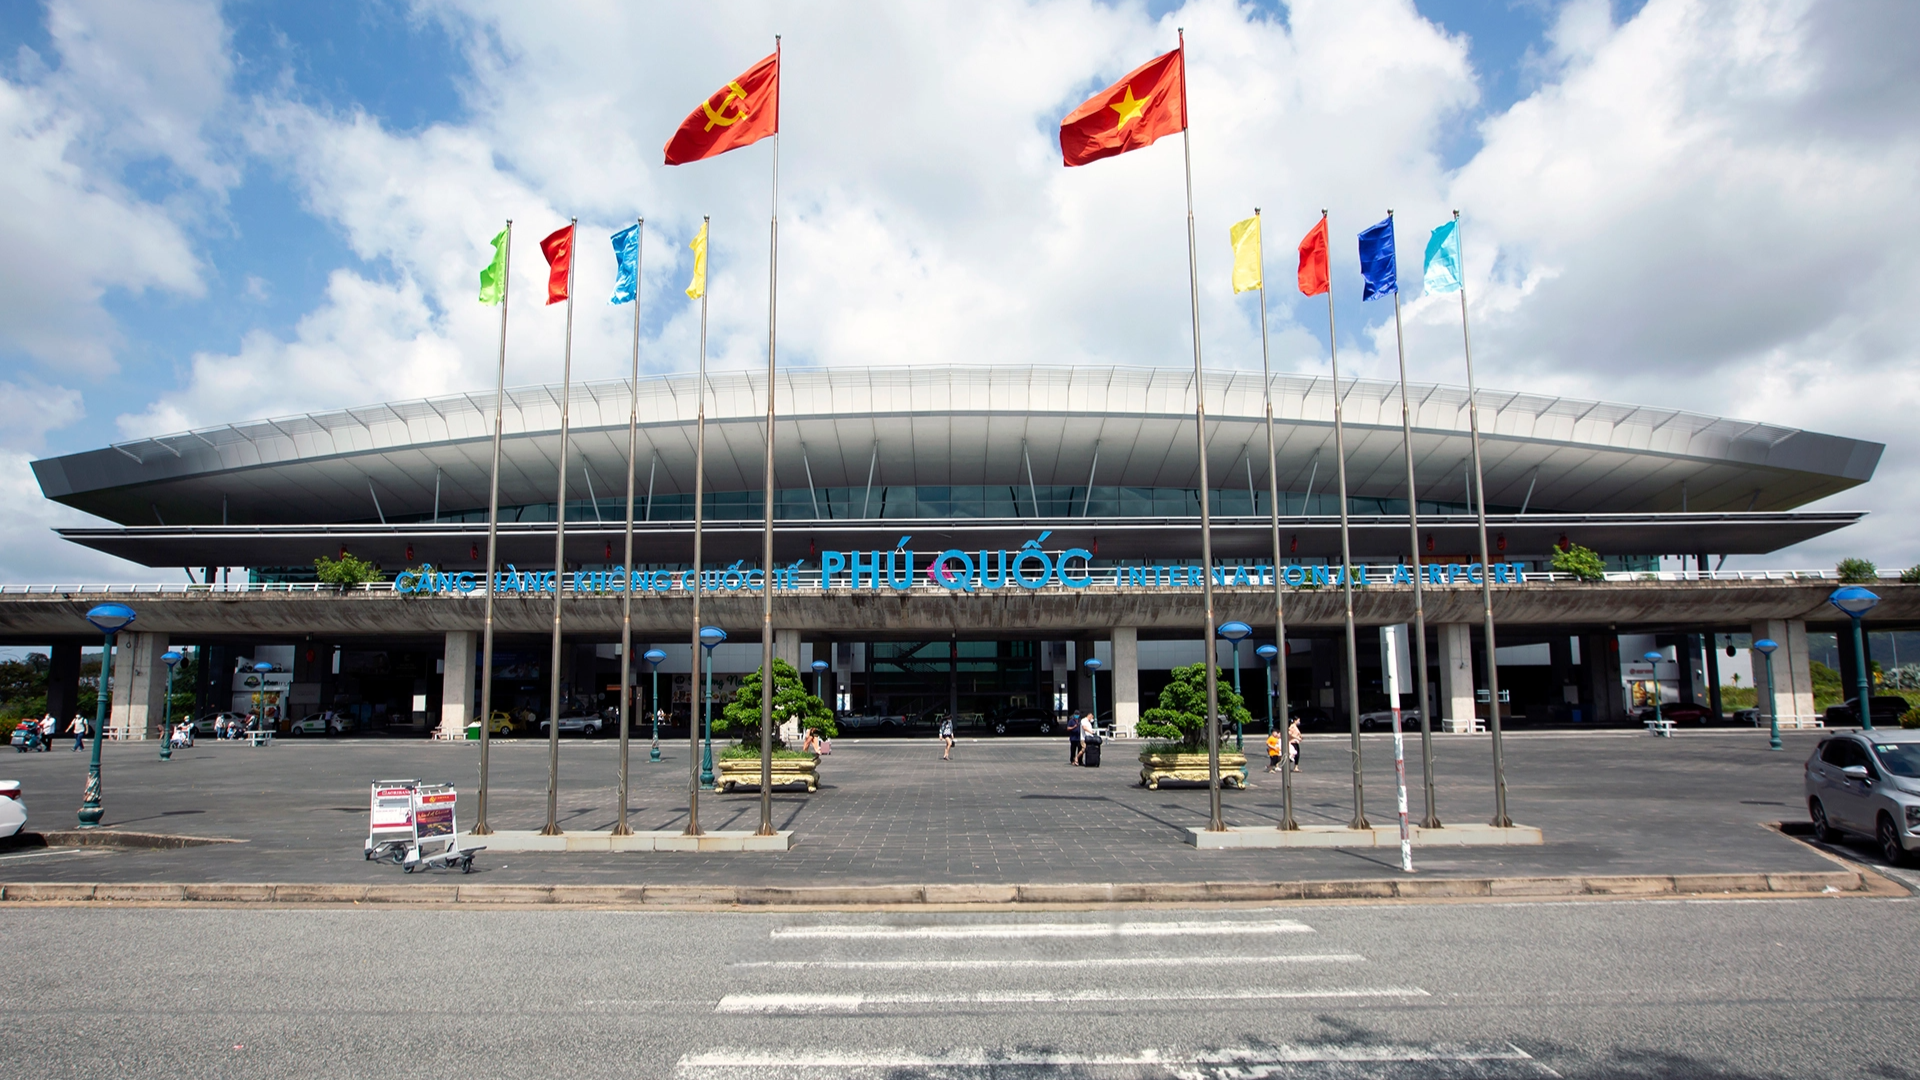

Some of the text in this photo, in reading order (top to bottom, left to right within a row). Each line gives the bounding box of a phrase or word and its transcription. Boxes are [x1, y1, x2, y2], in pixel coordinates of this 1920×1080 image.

[395, 563, 476, 593] CẢNG
[574, 566, 672, 592] KHÔNG
[682, 559, 765, 592] QUỐC
[773, 559, 804, 590] TẾ
[822, 530, 1093, 592] PHÚ QUỐC
